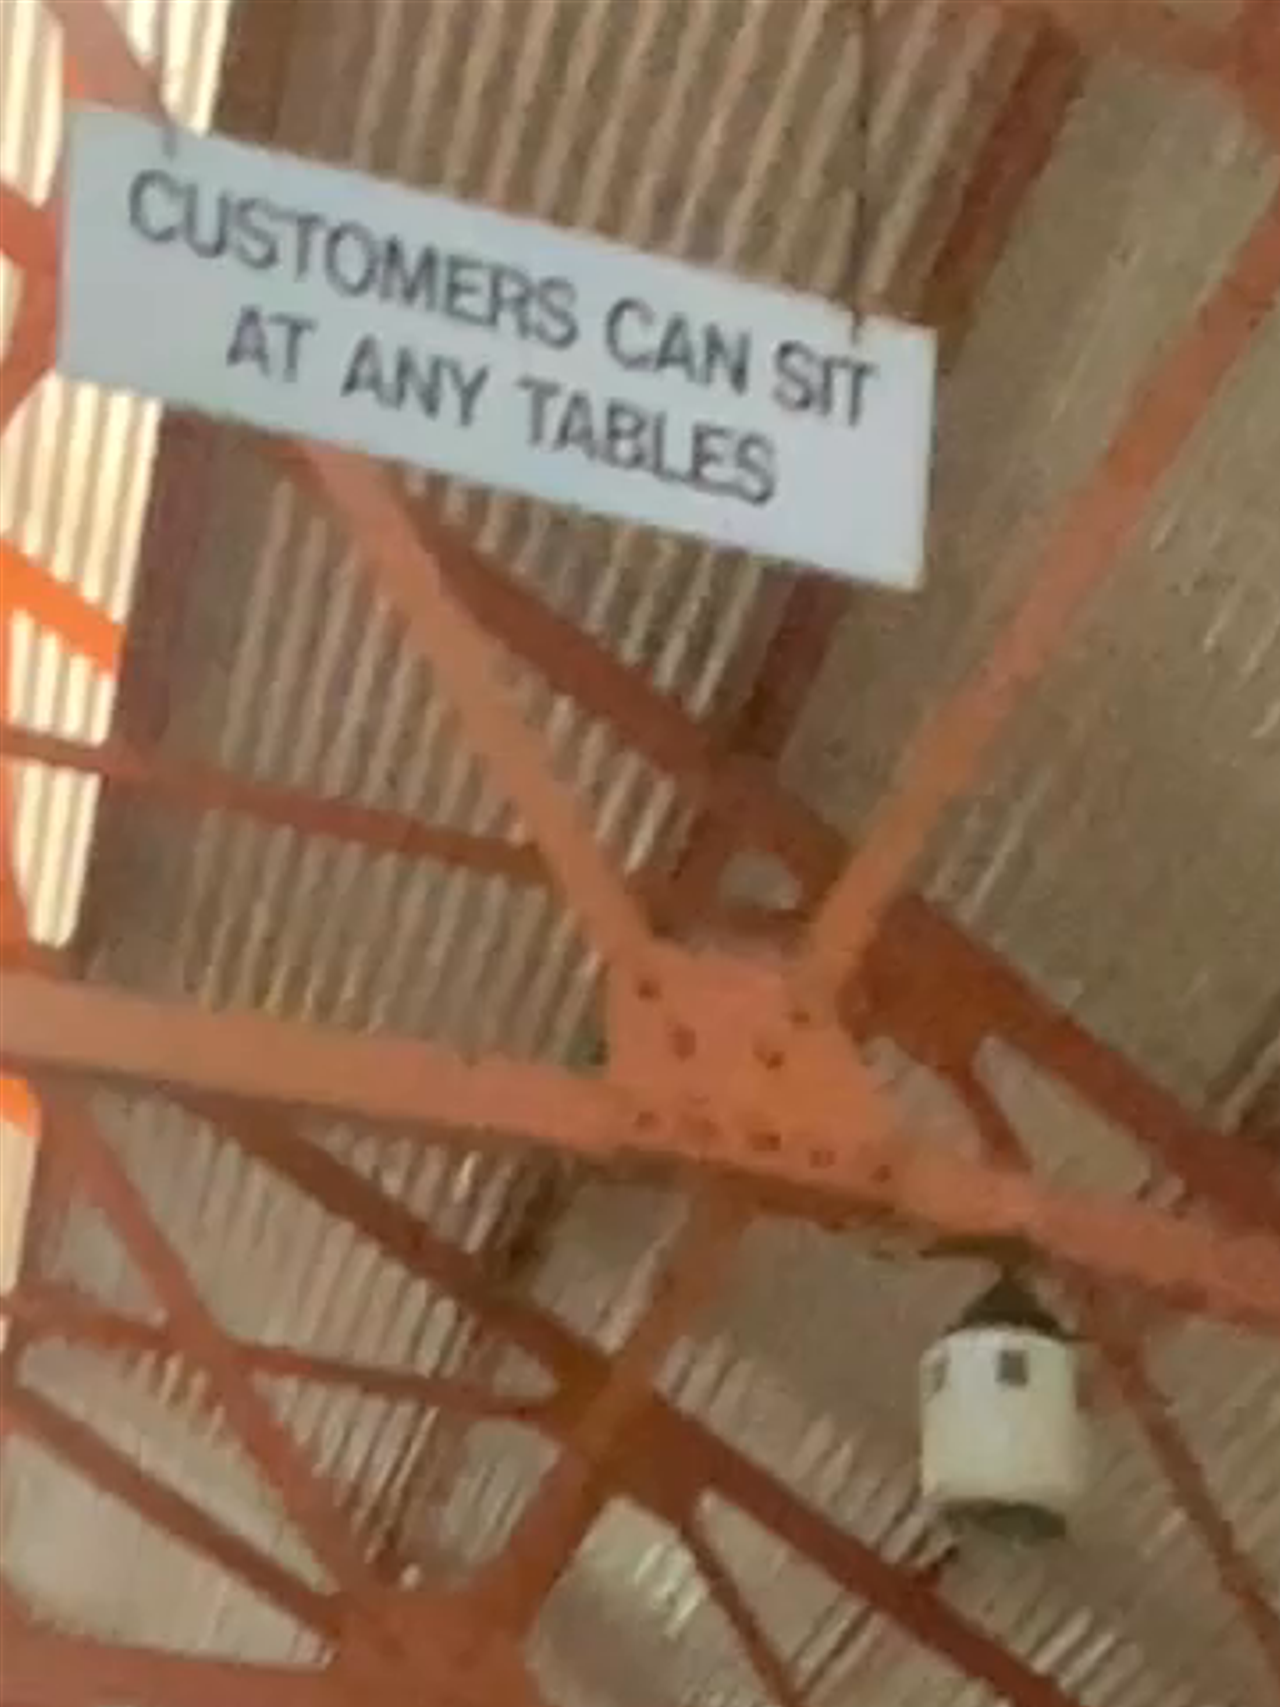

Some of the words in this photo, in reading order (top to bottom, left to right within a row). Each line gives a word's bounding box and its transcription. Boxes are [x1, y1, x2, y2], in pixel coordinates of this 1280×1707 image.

[126, 167, 580, 352] CUSTOMERS
[603, 296, 751, 401] CAN
[772, 340, 880, 428] SIT
[226, 306, 317, 383] AT
[340, 335, 491, 430] ANY
[514, 376, 778, 507] TABLES
